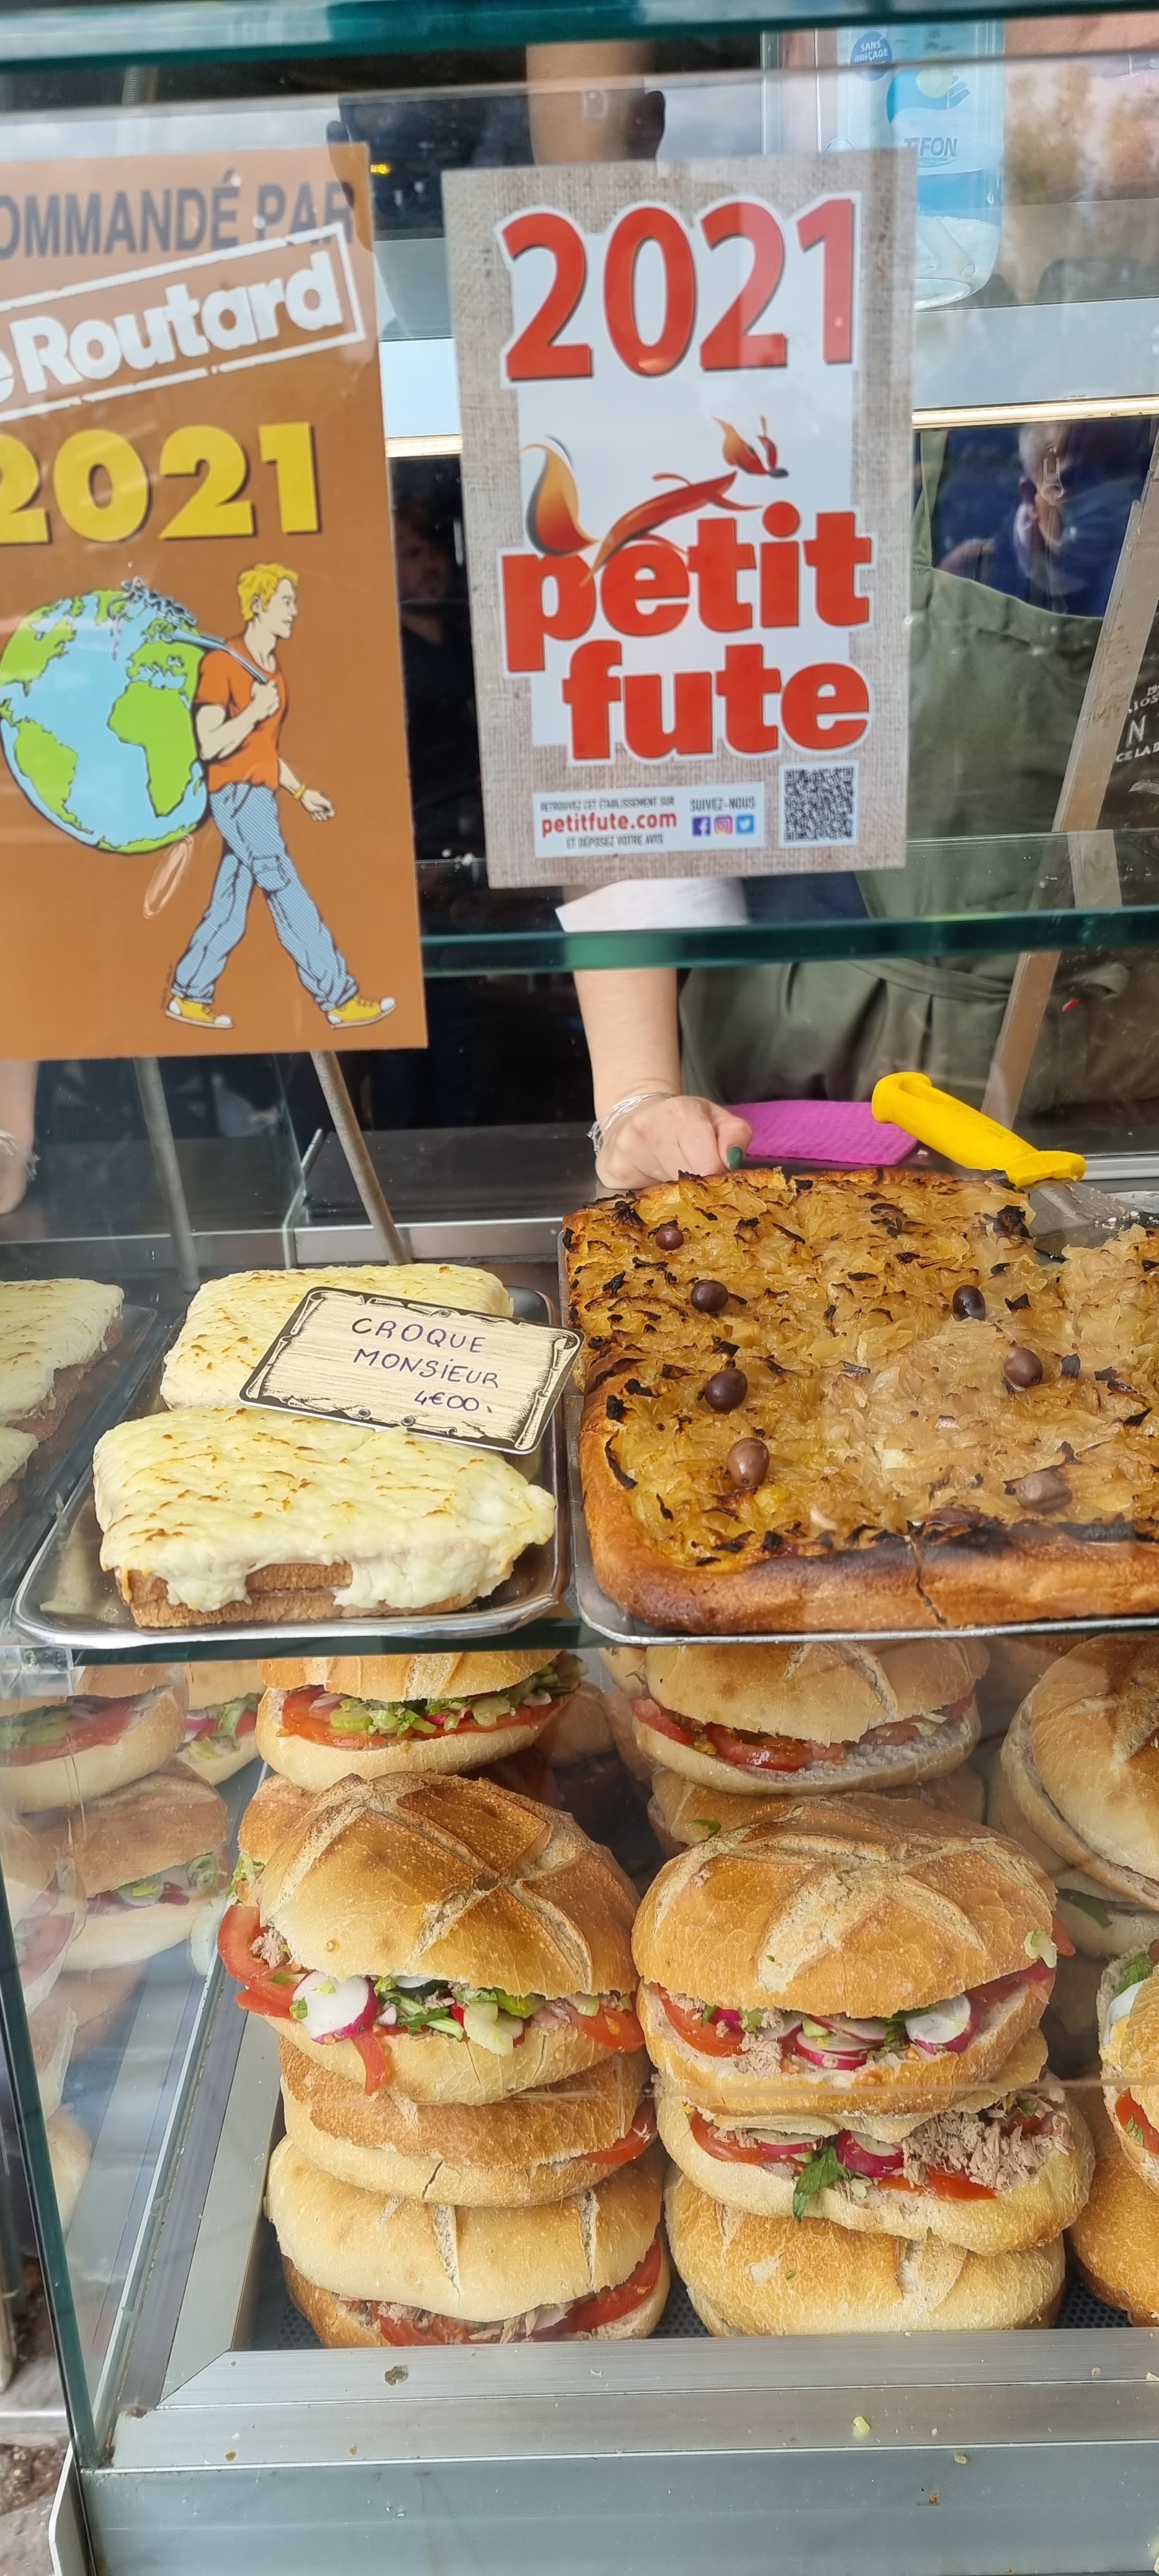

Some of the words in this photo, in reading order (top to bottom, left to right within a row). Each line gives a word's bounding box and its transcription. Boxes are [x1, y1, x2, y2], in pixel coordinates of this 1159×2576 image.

[860, 40, 881, 52] SANS
[255, 180, 354, 245] PAR
[501, 198, 856, 381] 2021
[8, 251, 343, 393] Routard
[501, 500, 872, 672] petit
[562, 639, 870, 760] fute
[540, 800, 581, 812] RETROUVEZ
[583, 799, 597, 810] CET
[659, 796, 675, 806] SUR
[690, 795, 756, 812] SUIVEZ-NOUS
[542, 812, 677, 838] petitfute.com
[566, 837, 576, 849] ET
[616, 834, 643, 846] VOTRE
[645, 833, 664, 845] AVIS
[352, 1318, 486, 1353] CROQUE
[414, 1390, 480, 1412] 4€00
